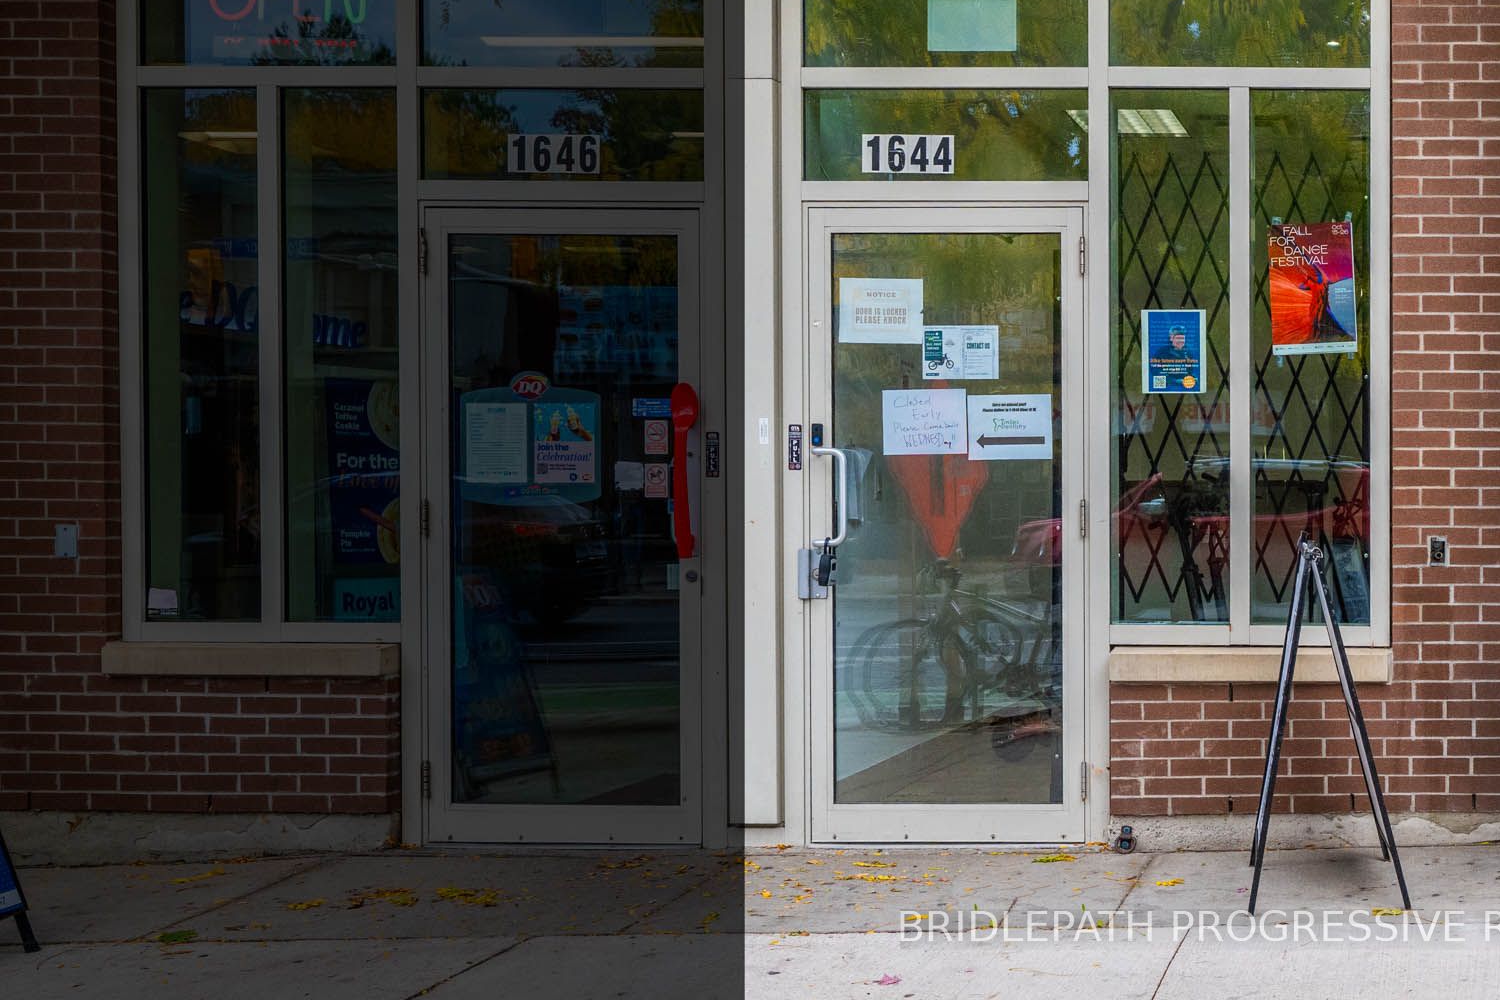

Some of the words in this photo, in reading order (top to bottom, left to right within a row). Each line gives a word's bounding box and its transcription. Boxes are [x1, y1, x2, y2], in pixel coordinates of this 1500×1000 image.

[512, 135, 598, 172] 1646
[866, 135, 952, 172] 1644
[1282, 226, 1313, 236] FALL
[1269, 236, 1296, 247] FOR
[1283, 244, 1329, 256] DANCE
[1270, 255, 1329, 267] FESTIVAL
[519, 381, 543, 395] DQ
[336, 452, 366, 468] For
[369, 453, 399, 470] the
[341, 590, 396, 617] Royal
